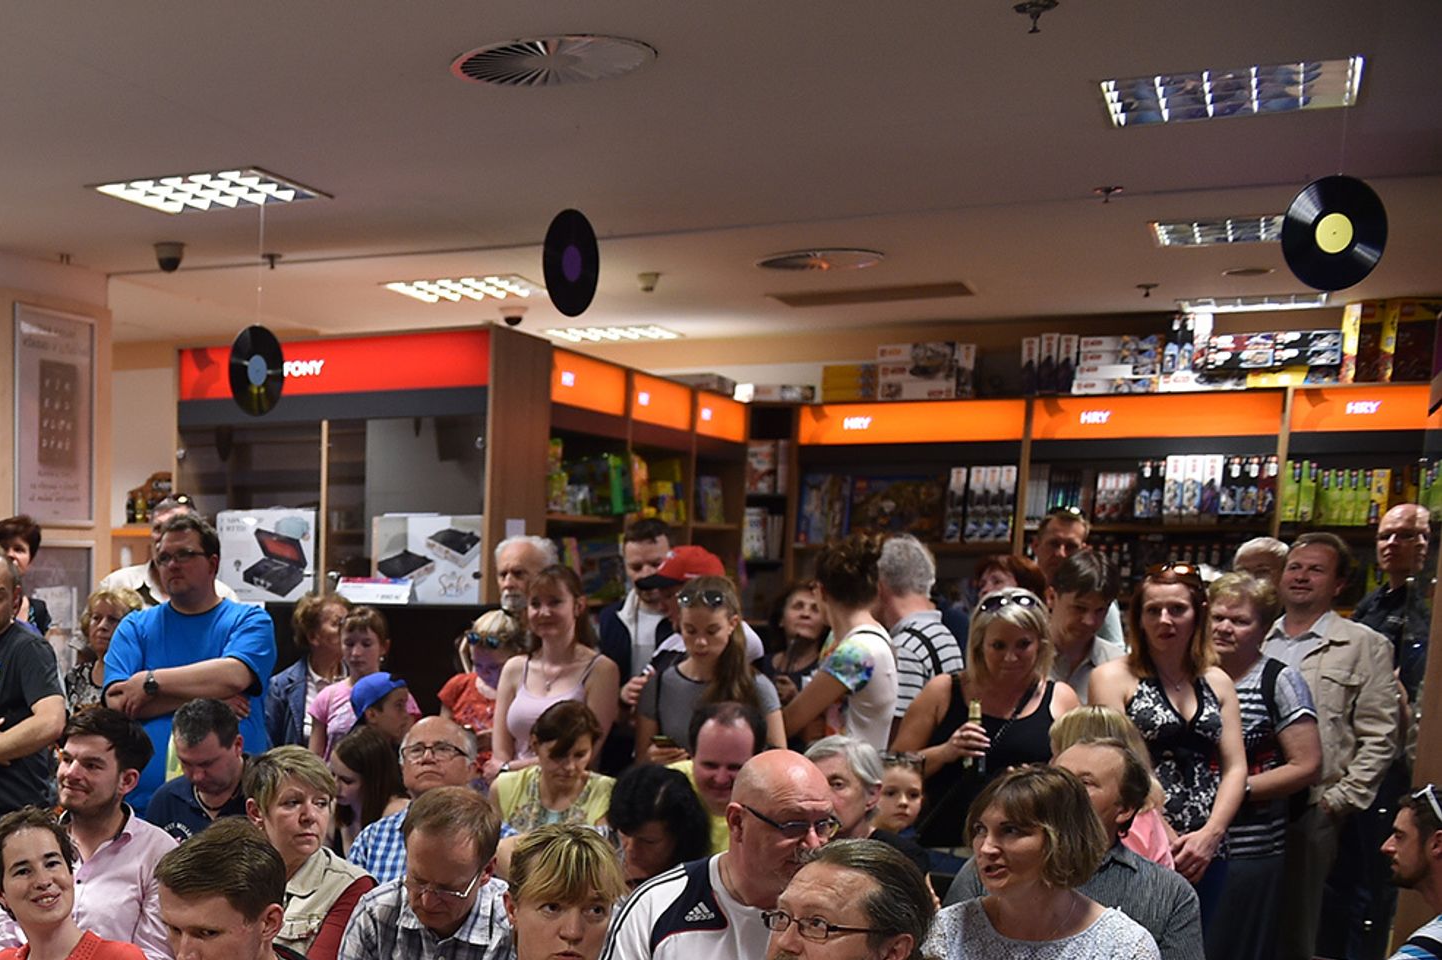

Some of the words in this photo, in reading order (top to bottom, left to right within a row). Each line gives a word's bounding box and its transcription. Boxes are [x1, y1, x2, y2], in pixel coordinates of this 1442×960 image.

[283, 360, 325, 377] FONY
[1346, 400, 1382, 415] HRY
[843, 416, 872, 430] HRY
[1080, 410, 1111, 424] HRY
